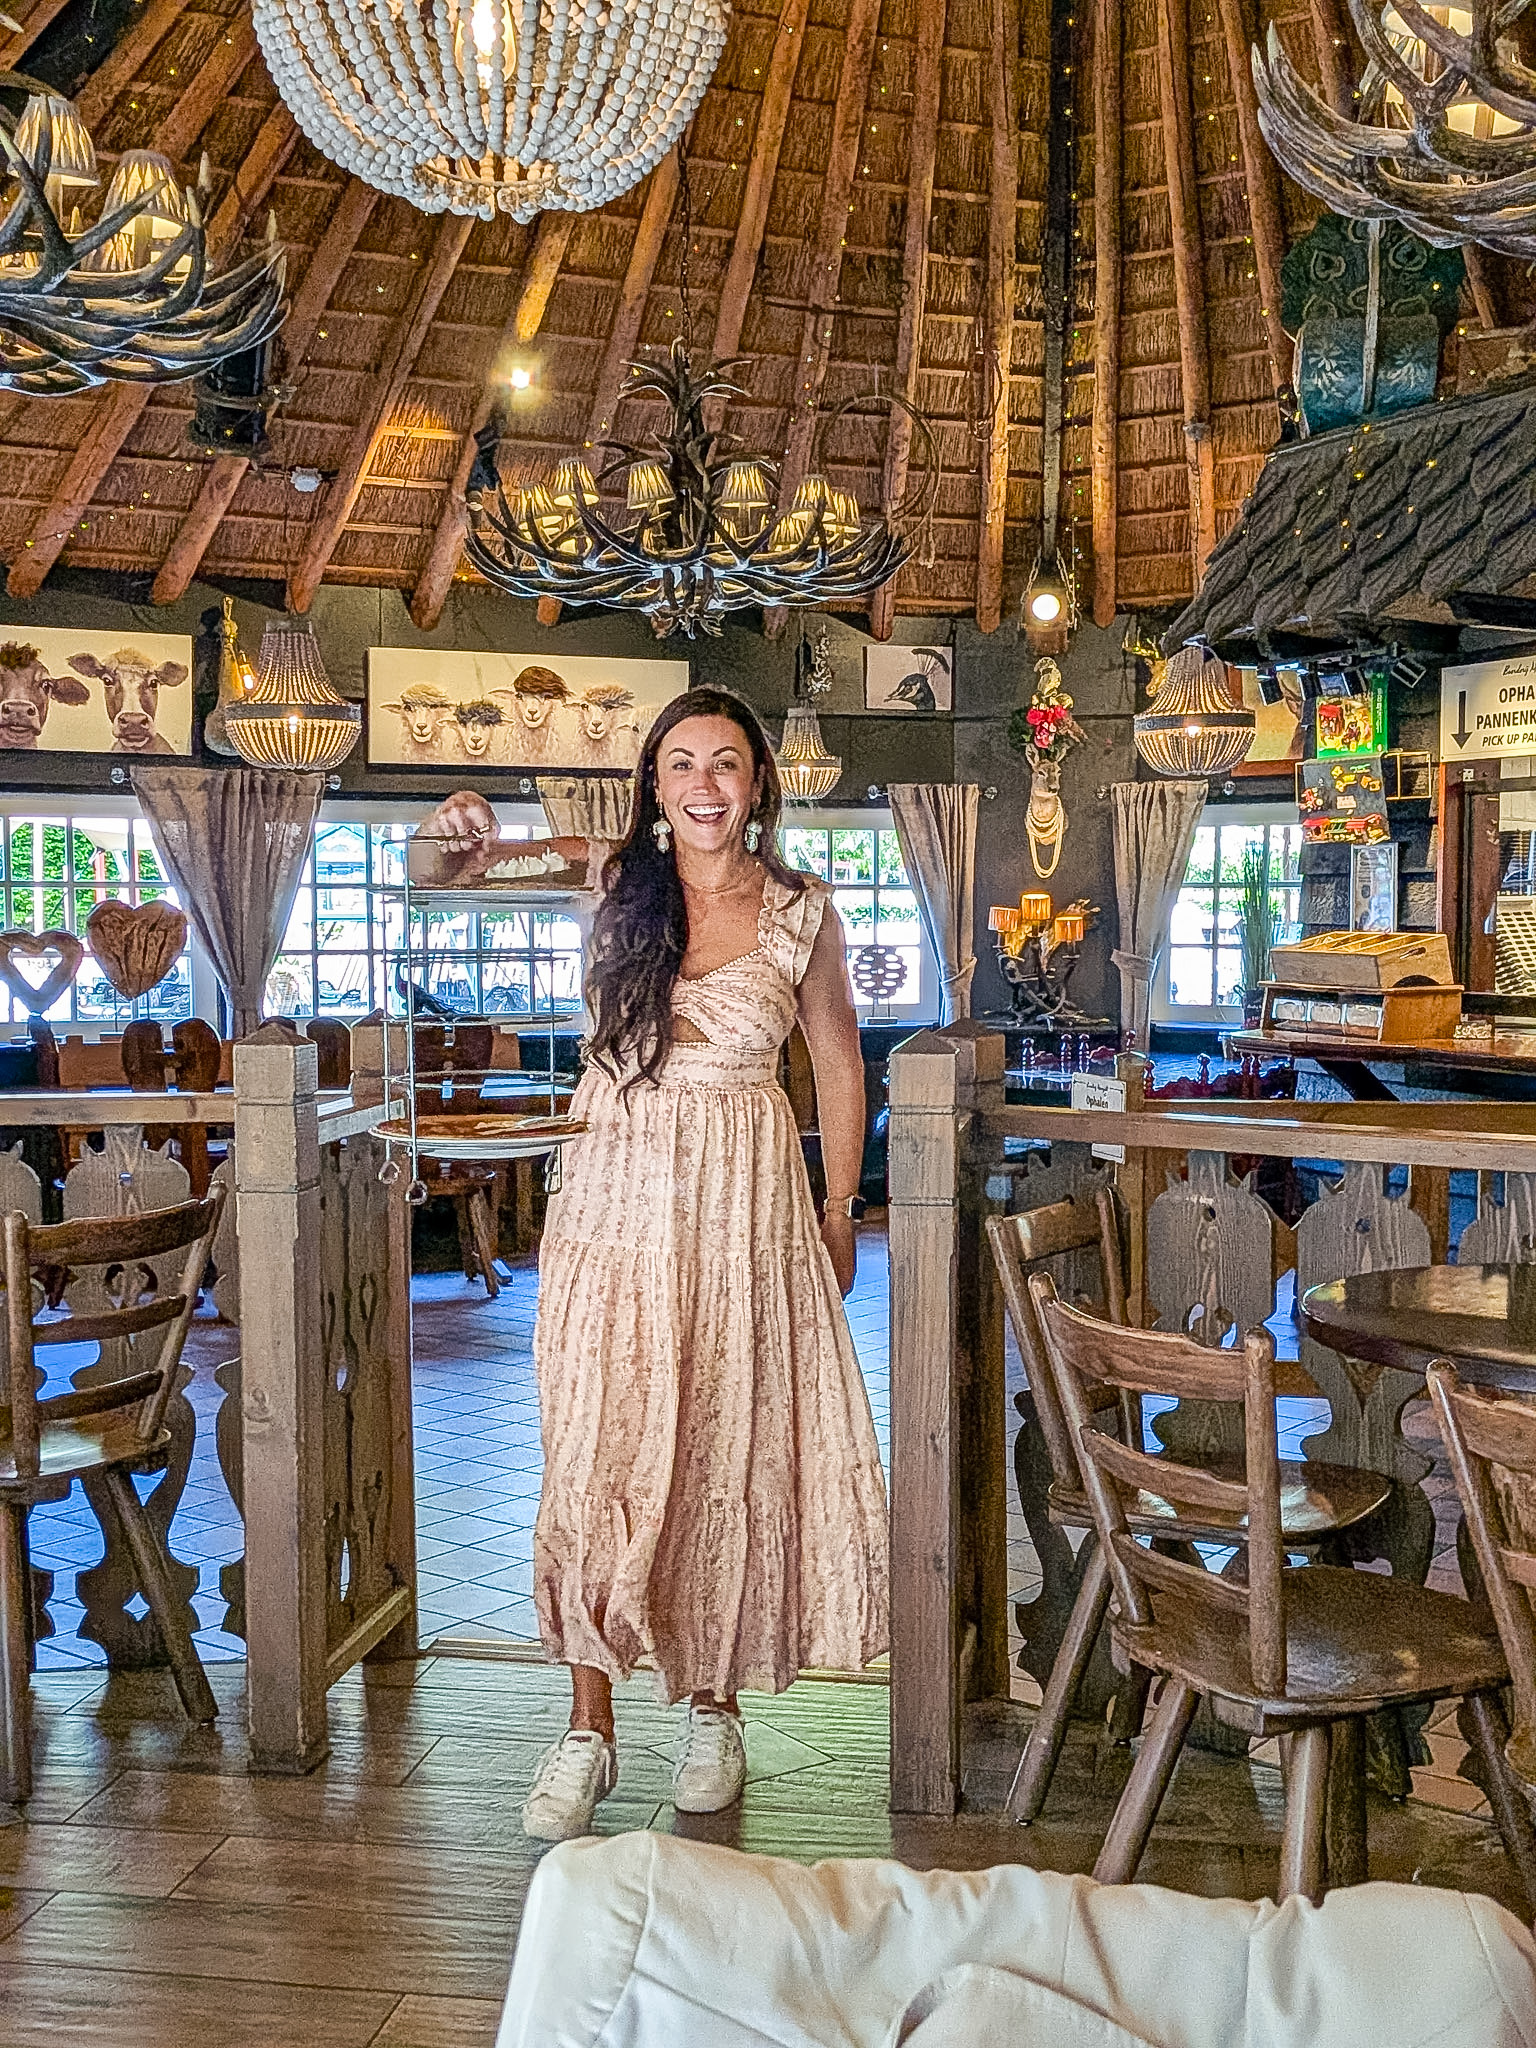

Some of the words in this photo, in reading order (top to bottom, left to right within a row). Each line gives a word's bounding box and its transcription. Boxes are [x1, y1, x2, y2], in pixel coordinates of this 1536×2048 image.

[1499, 685, 1535, 703] OPHA
[1476, 709, 1536, 730] PANNENK
[1482, 734, 1505, 747] PICK
[1507, 733, 1520, 745] UP
[1086, 1095, 1108, 1109] Ophalen
